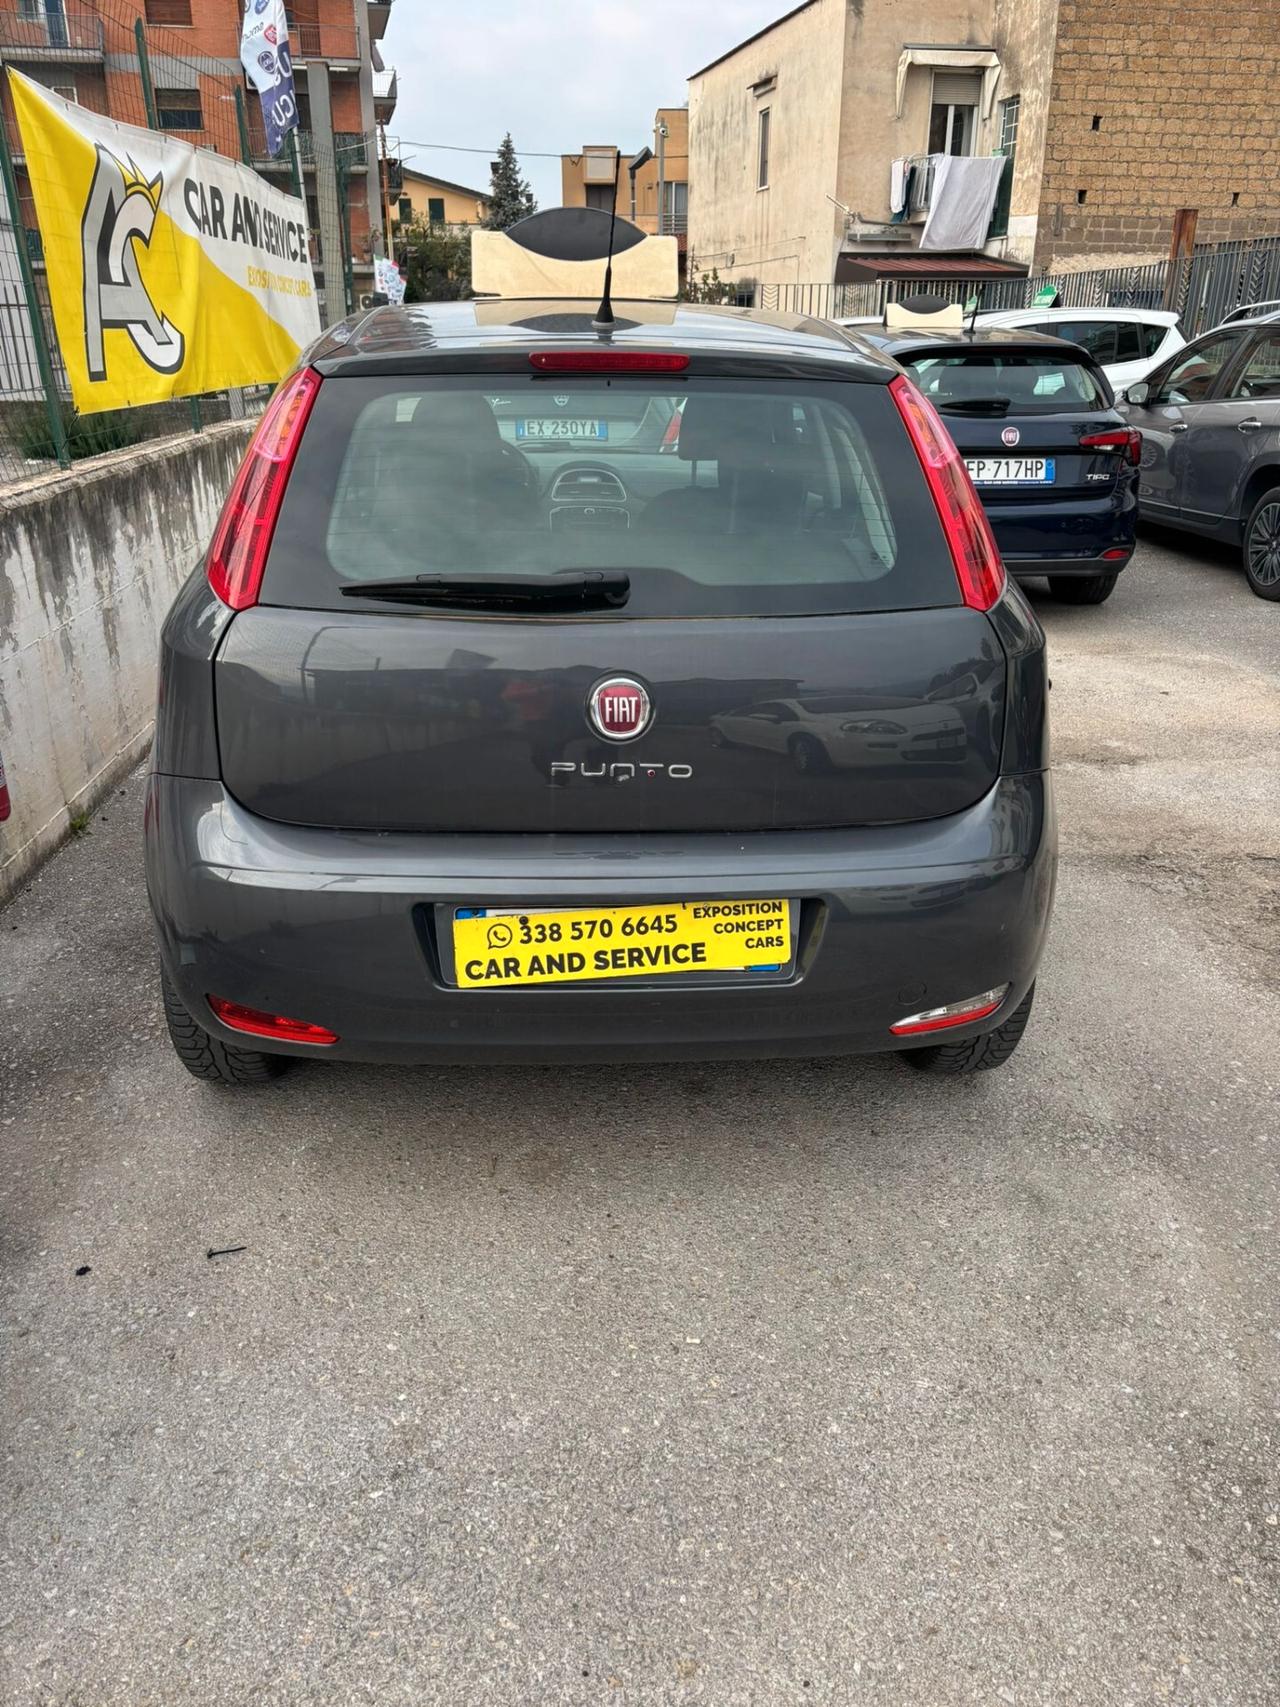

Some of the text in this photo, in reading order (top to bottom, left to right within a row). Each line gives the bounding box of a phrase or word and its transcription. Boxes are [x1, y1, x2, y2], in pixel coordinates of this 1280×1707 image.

[183, 177, 228, 241] CAR
[262, 207, 308, 265] SERVICE
[526, 420, 597, 435] EX 230YA
[993, 460, 1044, 478] 717HP
[604, 696, 638, 723] FIAT
[551, 761, 693, 779] PUNTO
[693, 901, 783, 919] EXPOSITION
[519, 914, 678, 945] 338 570 6645
[713, 918, 784, 935] CONCEPT
[745, 935, 784, 949] CARS
[465, 942, 707, 981] CAR AND SERVICE
